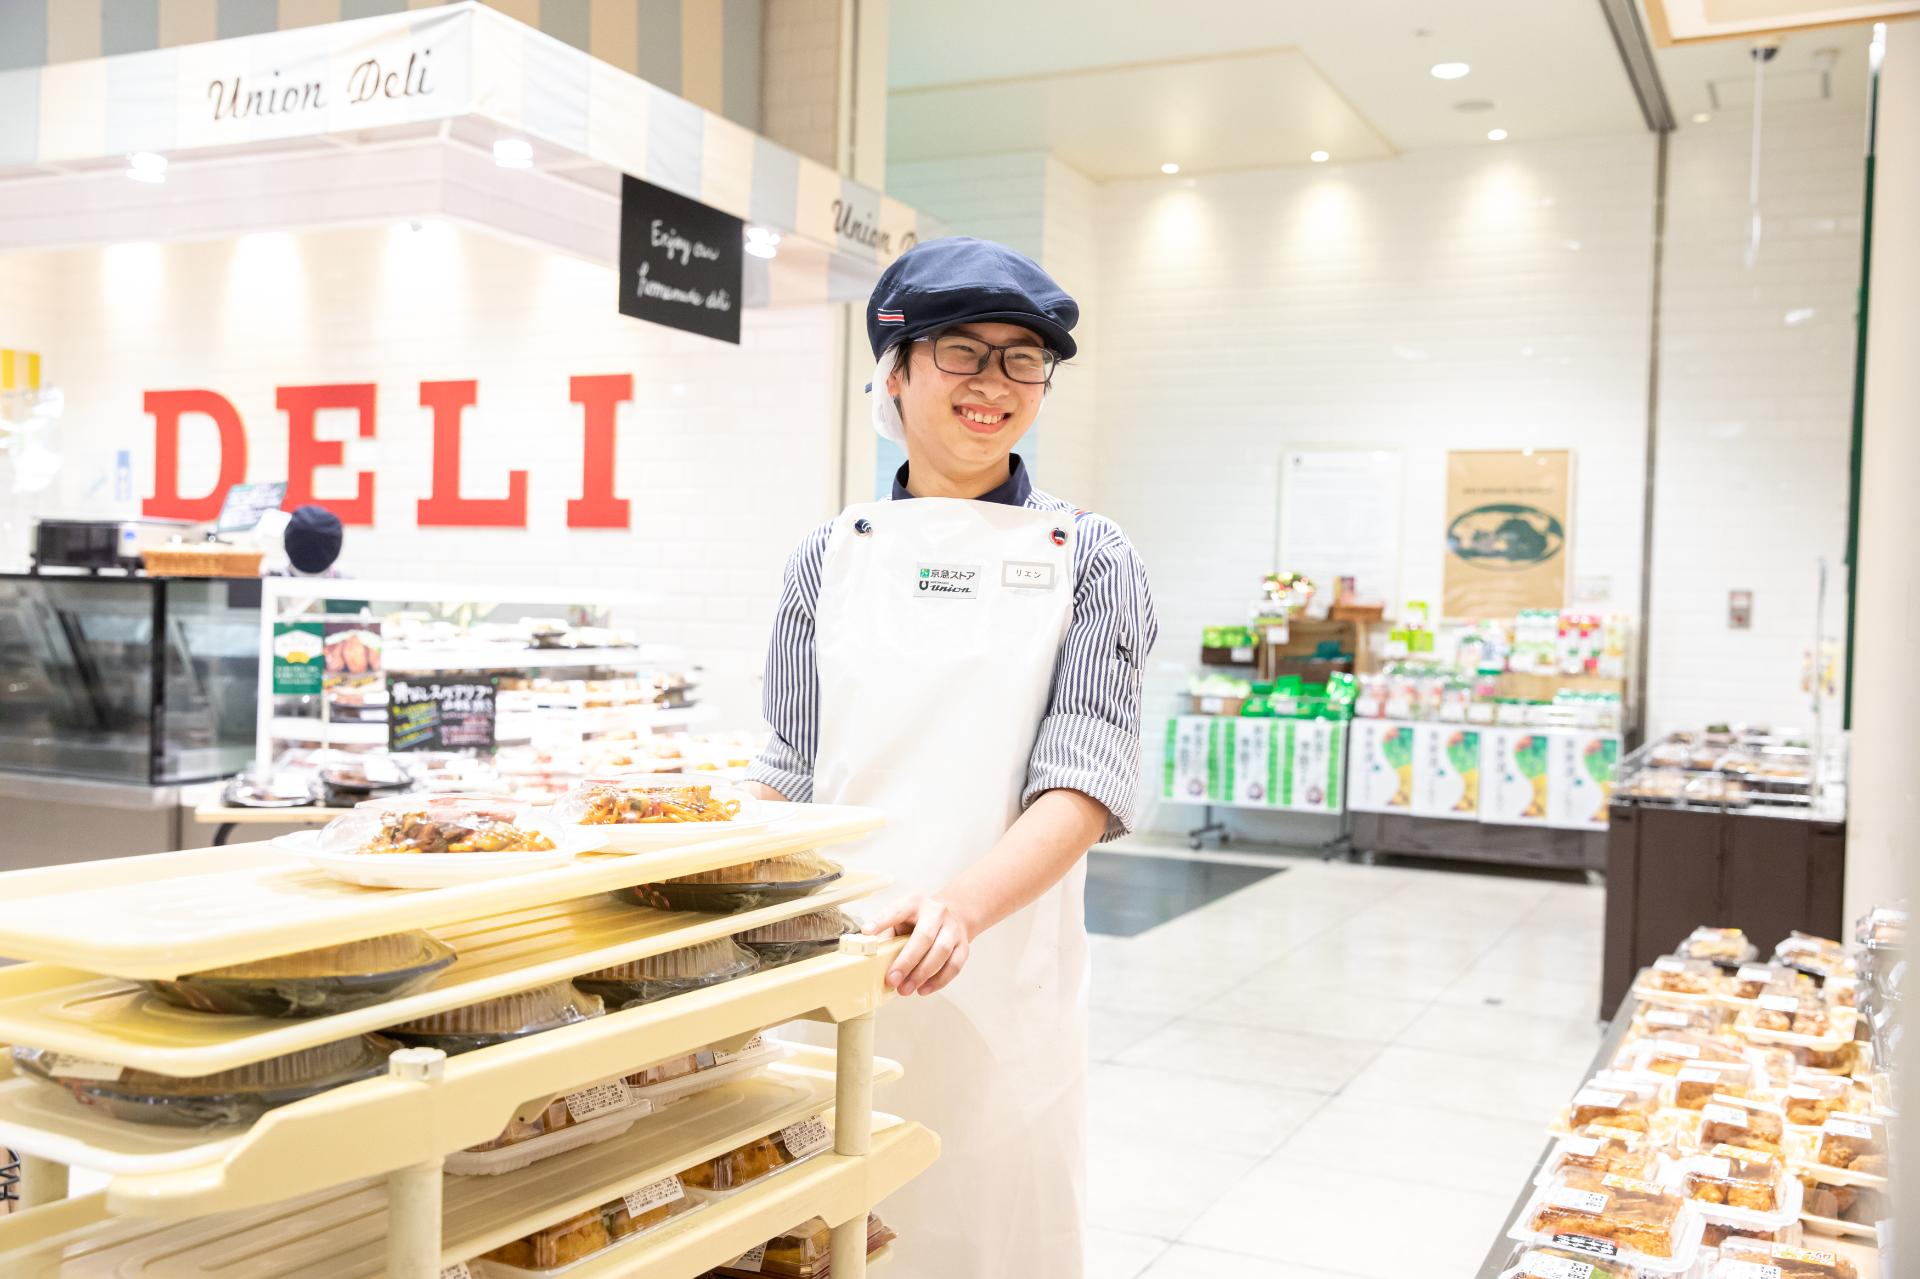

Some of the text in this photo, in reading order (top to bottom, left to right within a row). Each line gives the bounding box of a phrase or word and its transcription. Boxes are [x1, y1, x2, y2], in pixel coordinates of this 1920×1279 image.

[208, 49, 433, 120] Union Deli
[650, 219, 691, 266] Enjoy
[831, 200, 891, 255] Union
[142, 373, 633, 529] DELI
[930, 569, 976, 581] 京急ストア
[1016, 569, 1042, 579] リエン
